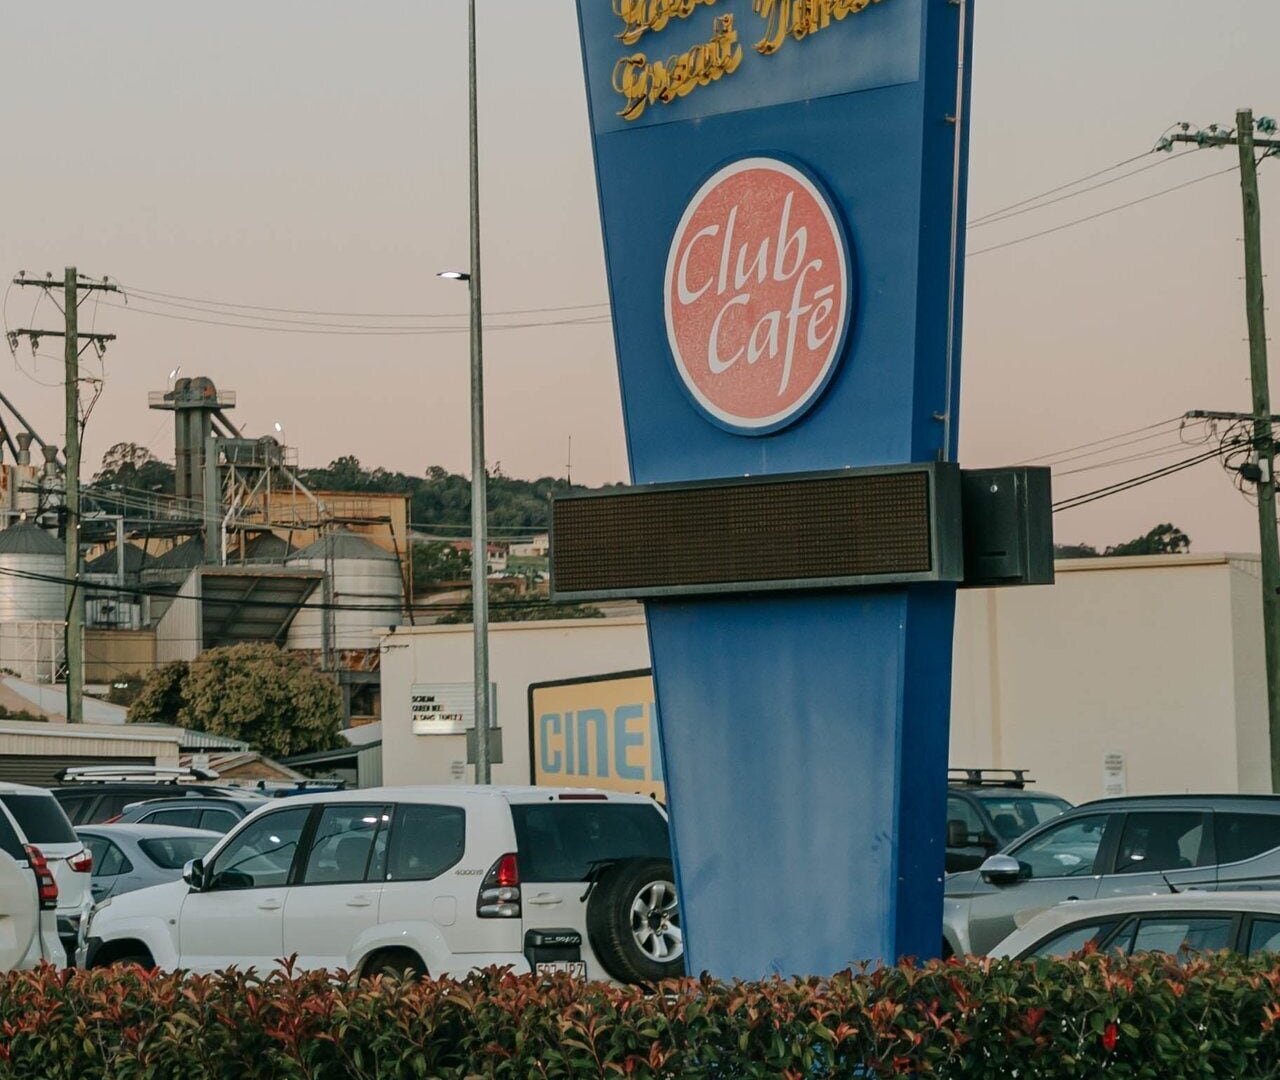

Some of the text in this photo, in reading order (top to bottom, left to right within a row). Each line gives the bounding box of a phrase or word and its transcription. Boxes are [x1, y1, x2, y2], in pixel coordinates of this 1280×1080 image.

[612, 13, 743, 121] Great
[677, 191, 808, 305] Club
[540, 702, 664, 782] CINE
